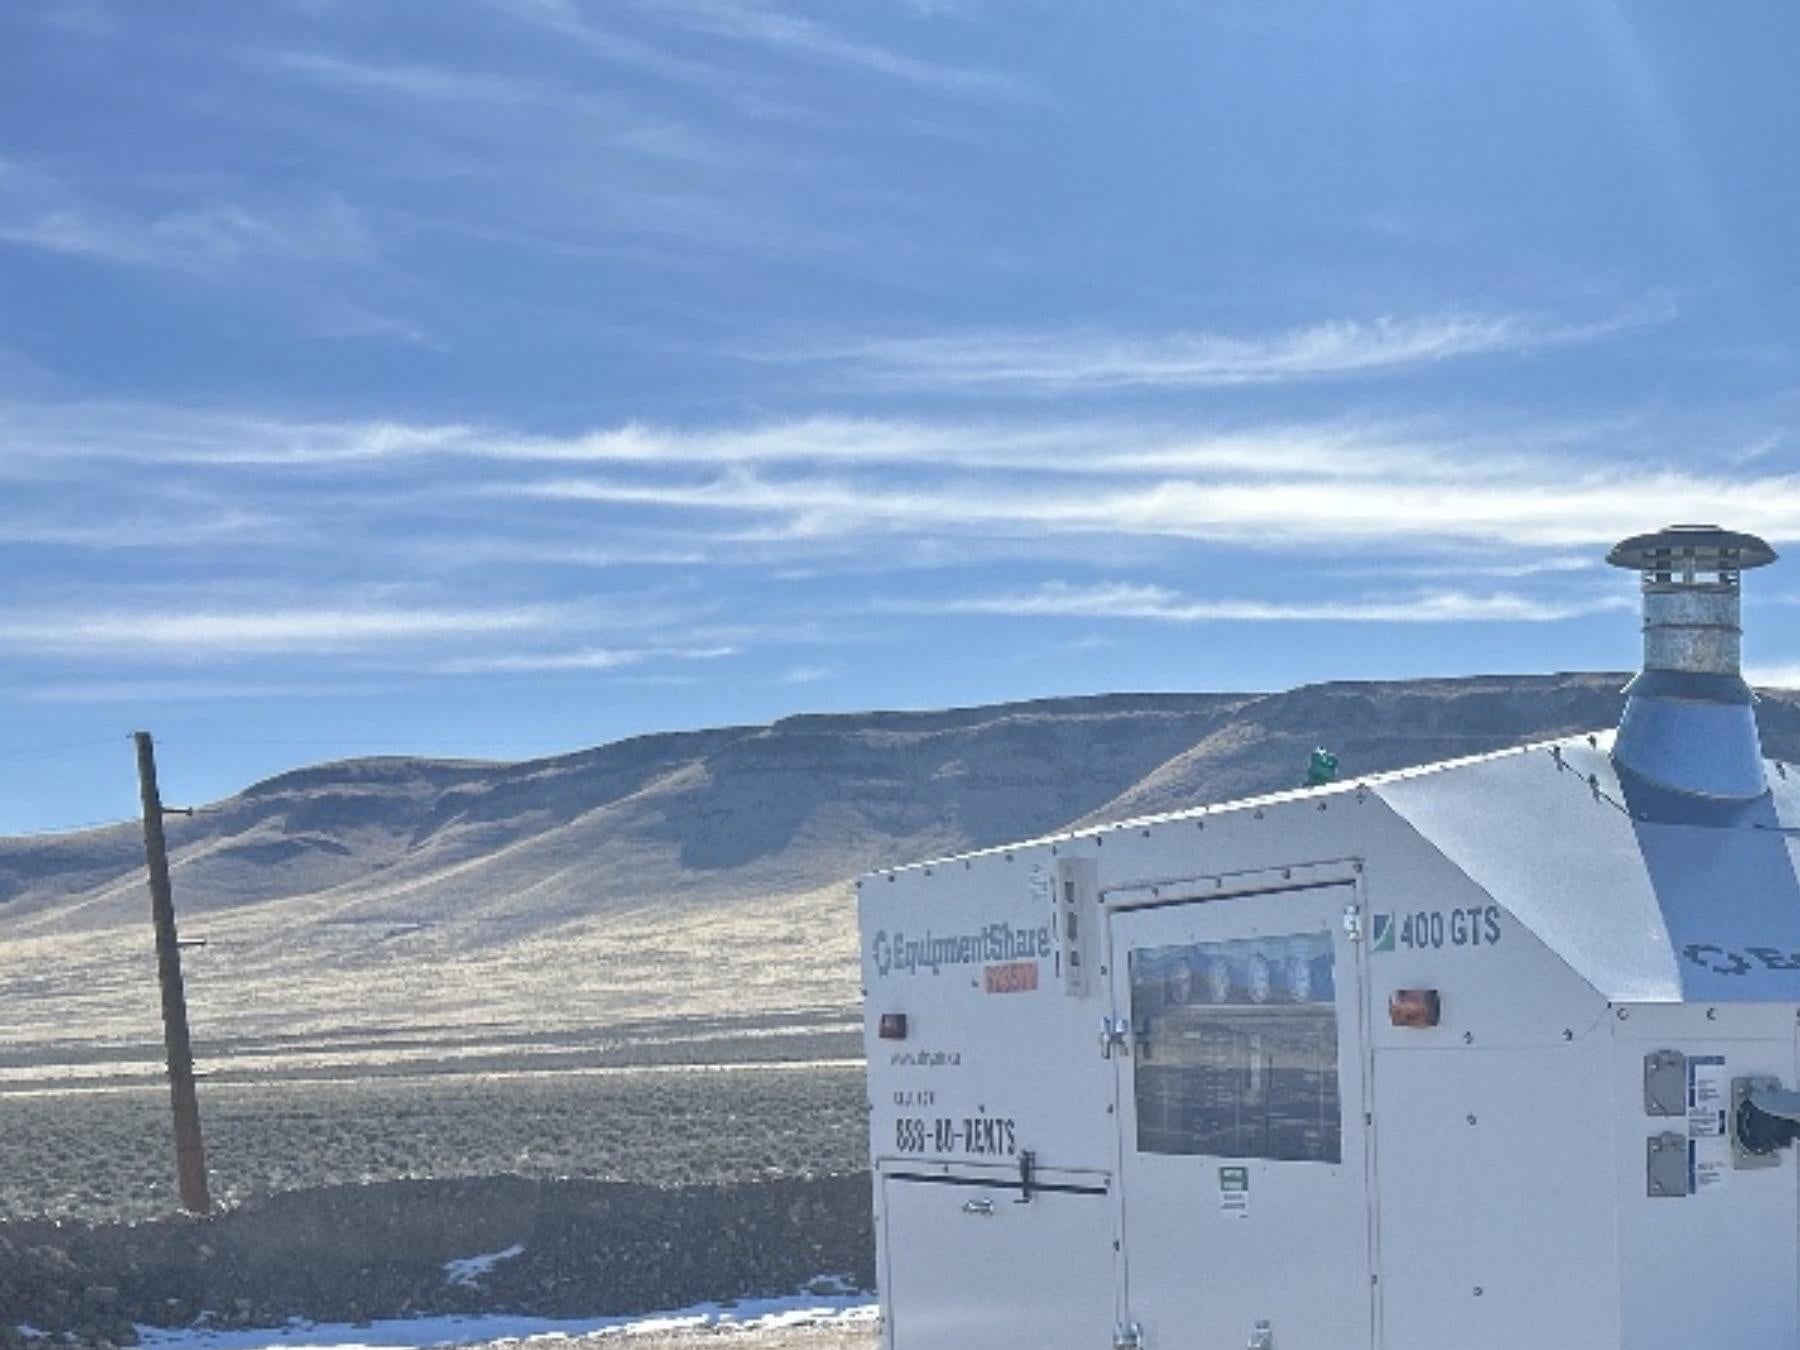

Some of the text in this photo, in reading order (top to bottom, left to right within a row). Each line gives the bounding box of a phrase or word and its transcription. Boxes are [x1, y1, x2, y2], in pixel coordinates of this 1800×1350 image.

[893, 920, 1051, 976] EquipmentShare
[1400, 905, 1500, 949] 400 GTS
